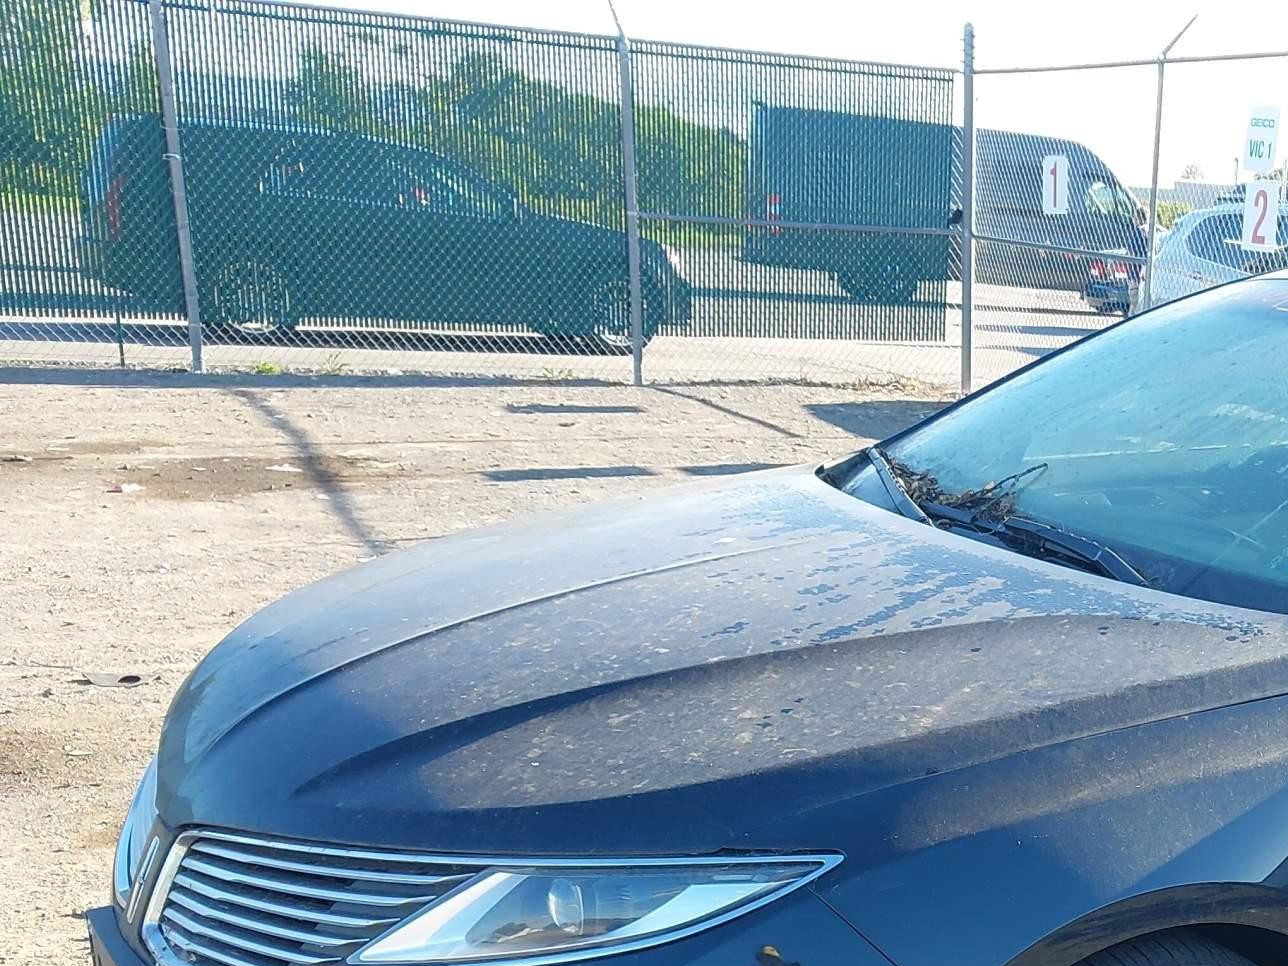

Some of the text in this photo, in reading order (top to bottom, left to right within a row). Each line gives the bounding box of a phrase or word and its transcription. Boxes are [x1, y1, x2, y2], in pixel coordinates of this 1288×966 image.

[1250, 118, 1275, 128] GEICO
[1249, 139, 1273, 160] VIC 1
[1049, 161, 1058, 208] 1
[1251, 189, 1268, 245] 2
